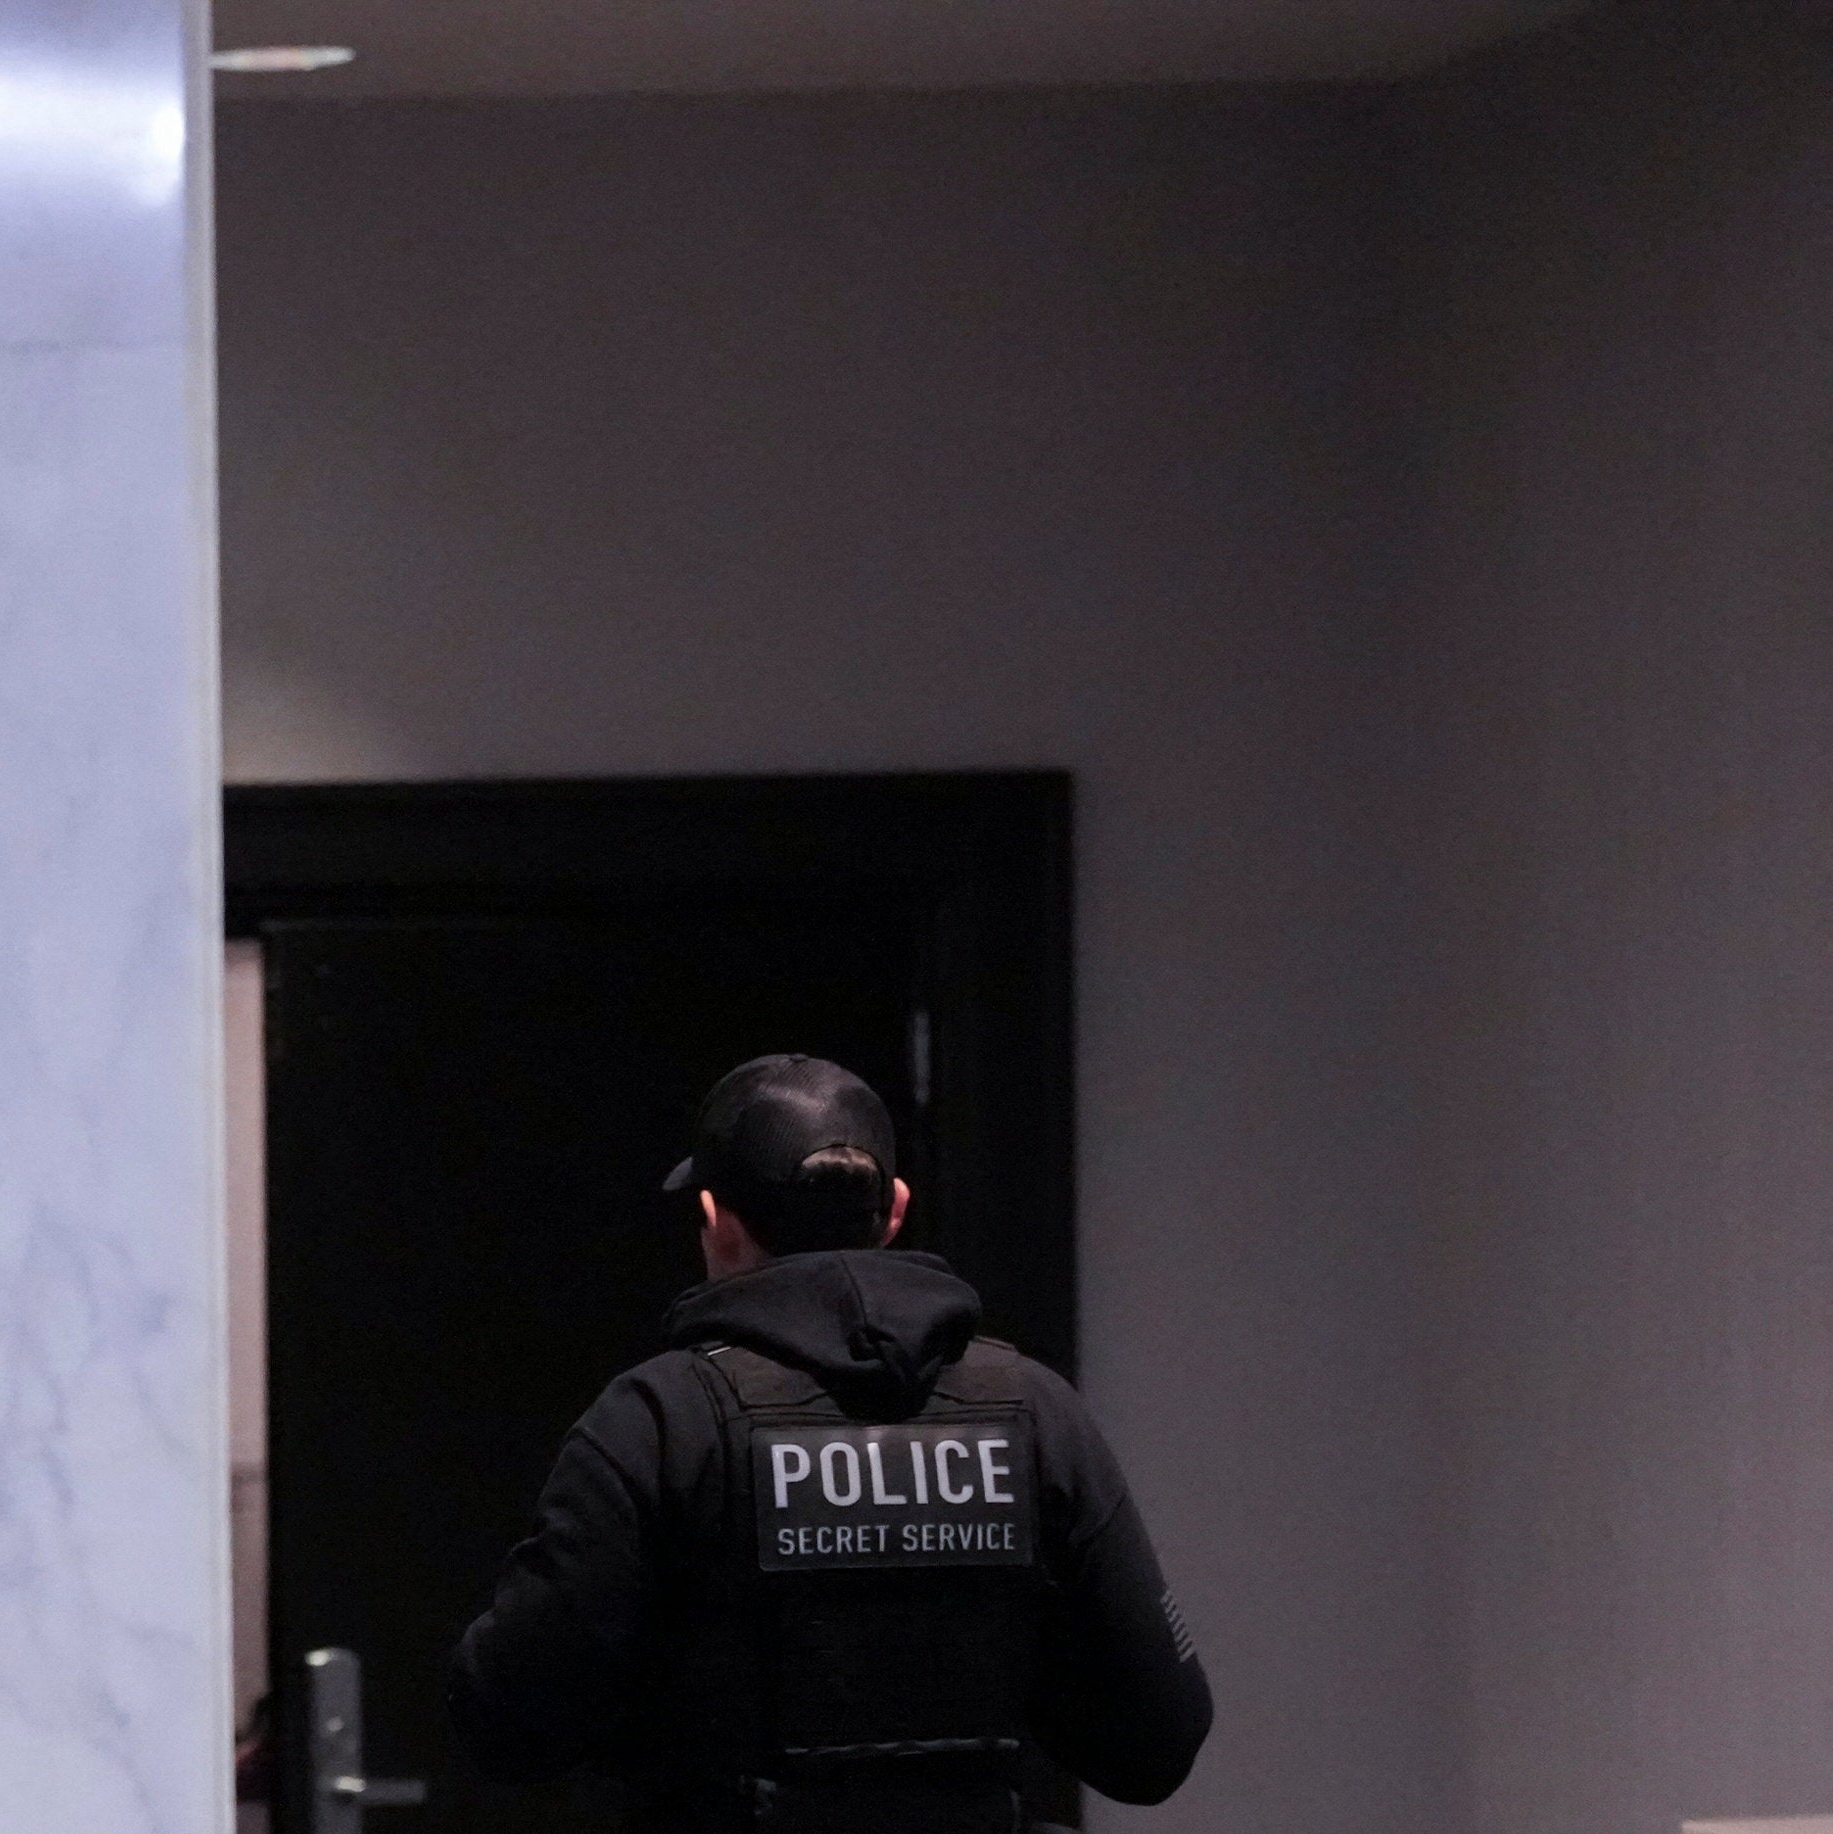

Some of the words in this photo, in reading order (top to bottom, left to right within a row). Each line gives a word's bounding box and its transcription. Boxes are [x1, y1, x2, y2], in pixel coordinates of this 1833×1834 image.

[770, 1438, 1015, 1509] POLICE
[777, 1525, 891, 1556] SECRET
[901, 1523, 1016, 1552] SERVICE
